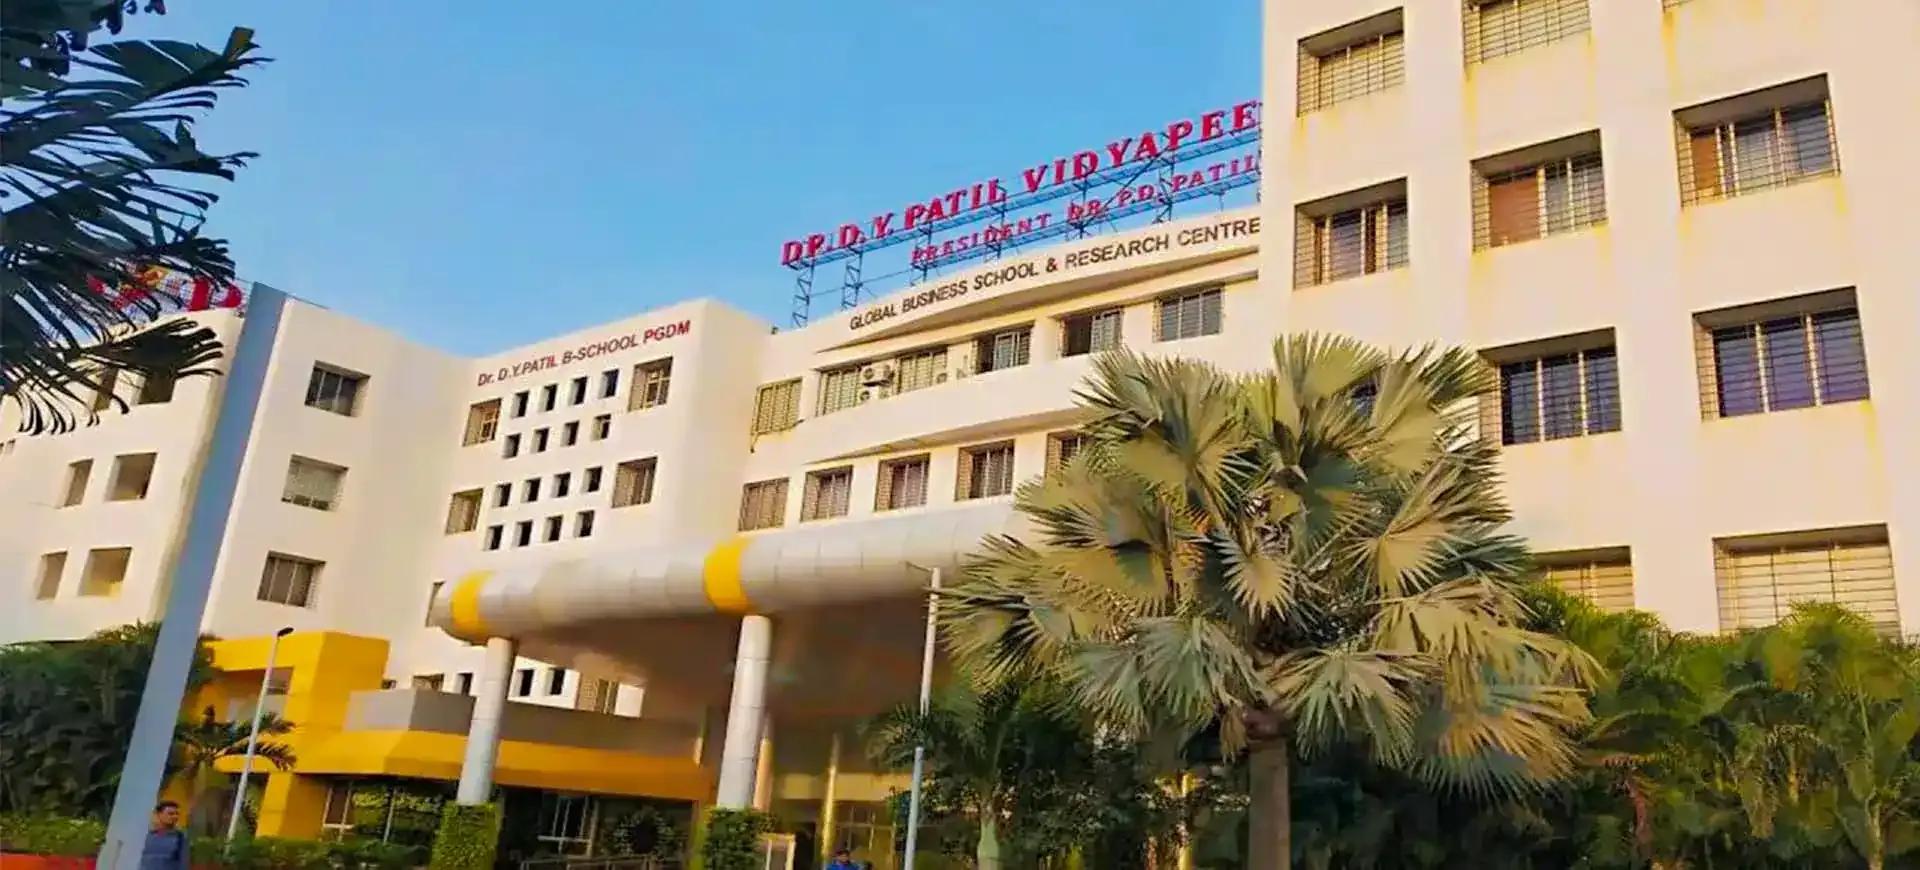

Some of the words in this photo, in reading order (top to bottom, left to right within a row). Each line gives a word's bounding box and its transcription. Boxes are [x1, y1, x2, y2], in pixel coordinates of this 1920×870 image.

[904, 179, 1007, 229] PATIL
[911, 212, 1051, 265] PRESIDENT
[1172, 154, 1257, 192] PATIL
[850, 304, 898, 330] GLOBAL
[901, 280, 968, 313] BUSINESS
[973, 262, 1039, 290] SCHOOL
[1045, 253, 1058, 273] &
[1064, 233, 1169, 269] RESEARCH
[1177, 216, 1260, 246] CENTRE
[562, 334, 639, 365] B-SCHOOL
[643, 320, 691, 345] PGDM
